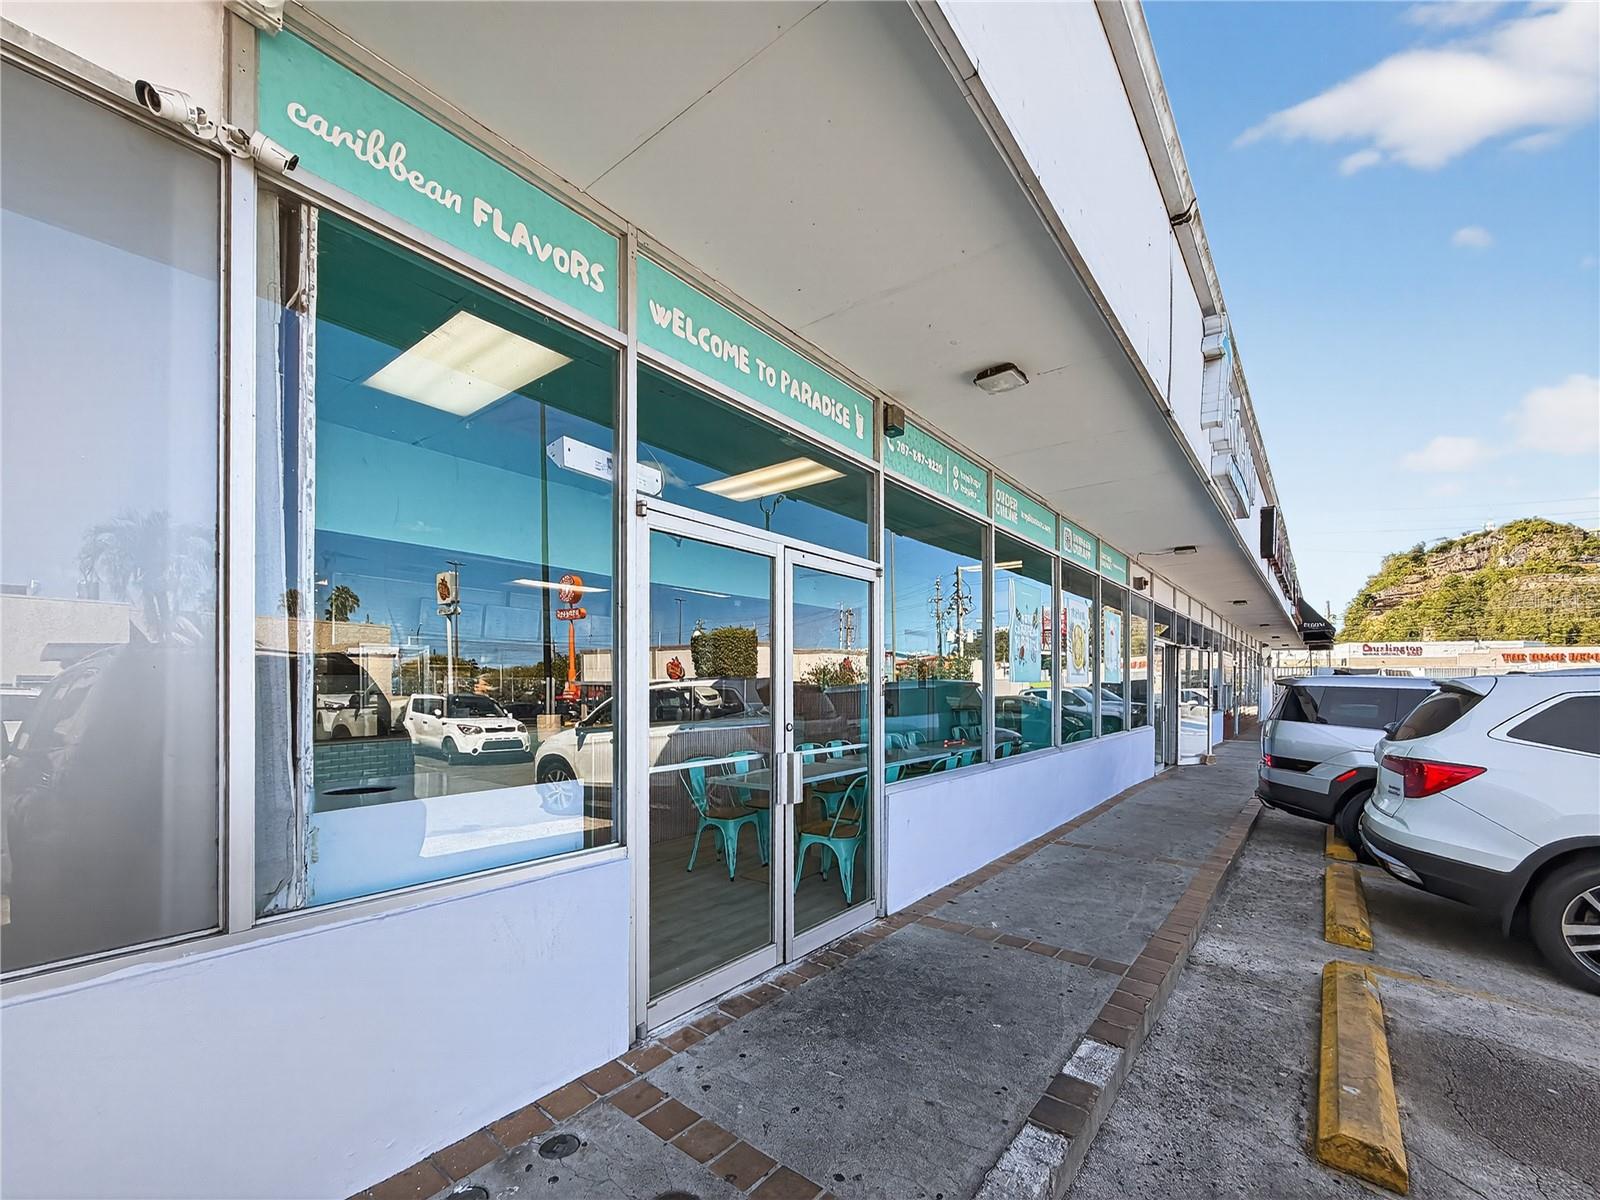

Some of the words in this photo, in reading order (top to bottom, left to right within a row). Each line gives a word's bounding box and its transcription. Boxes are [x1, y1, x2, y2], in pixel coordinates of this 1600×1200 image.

[287, 102, 462, 214] caribbean
[473, 197, 606, 293] FLAVORS
[755, 358, 777, 388] TO
